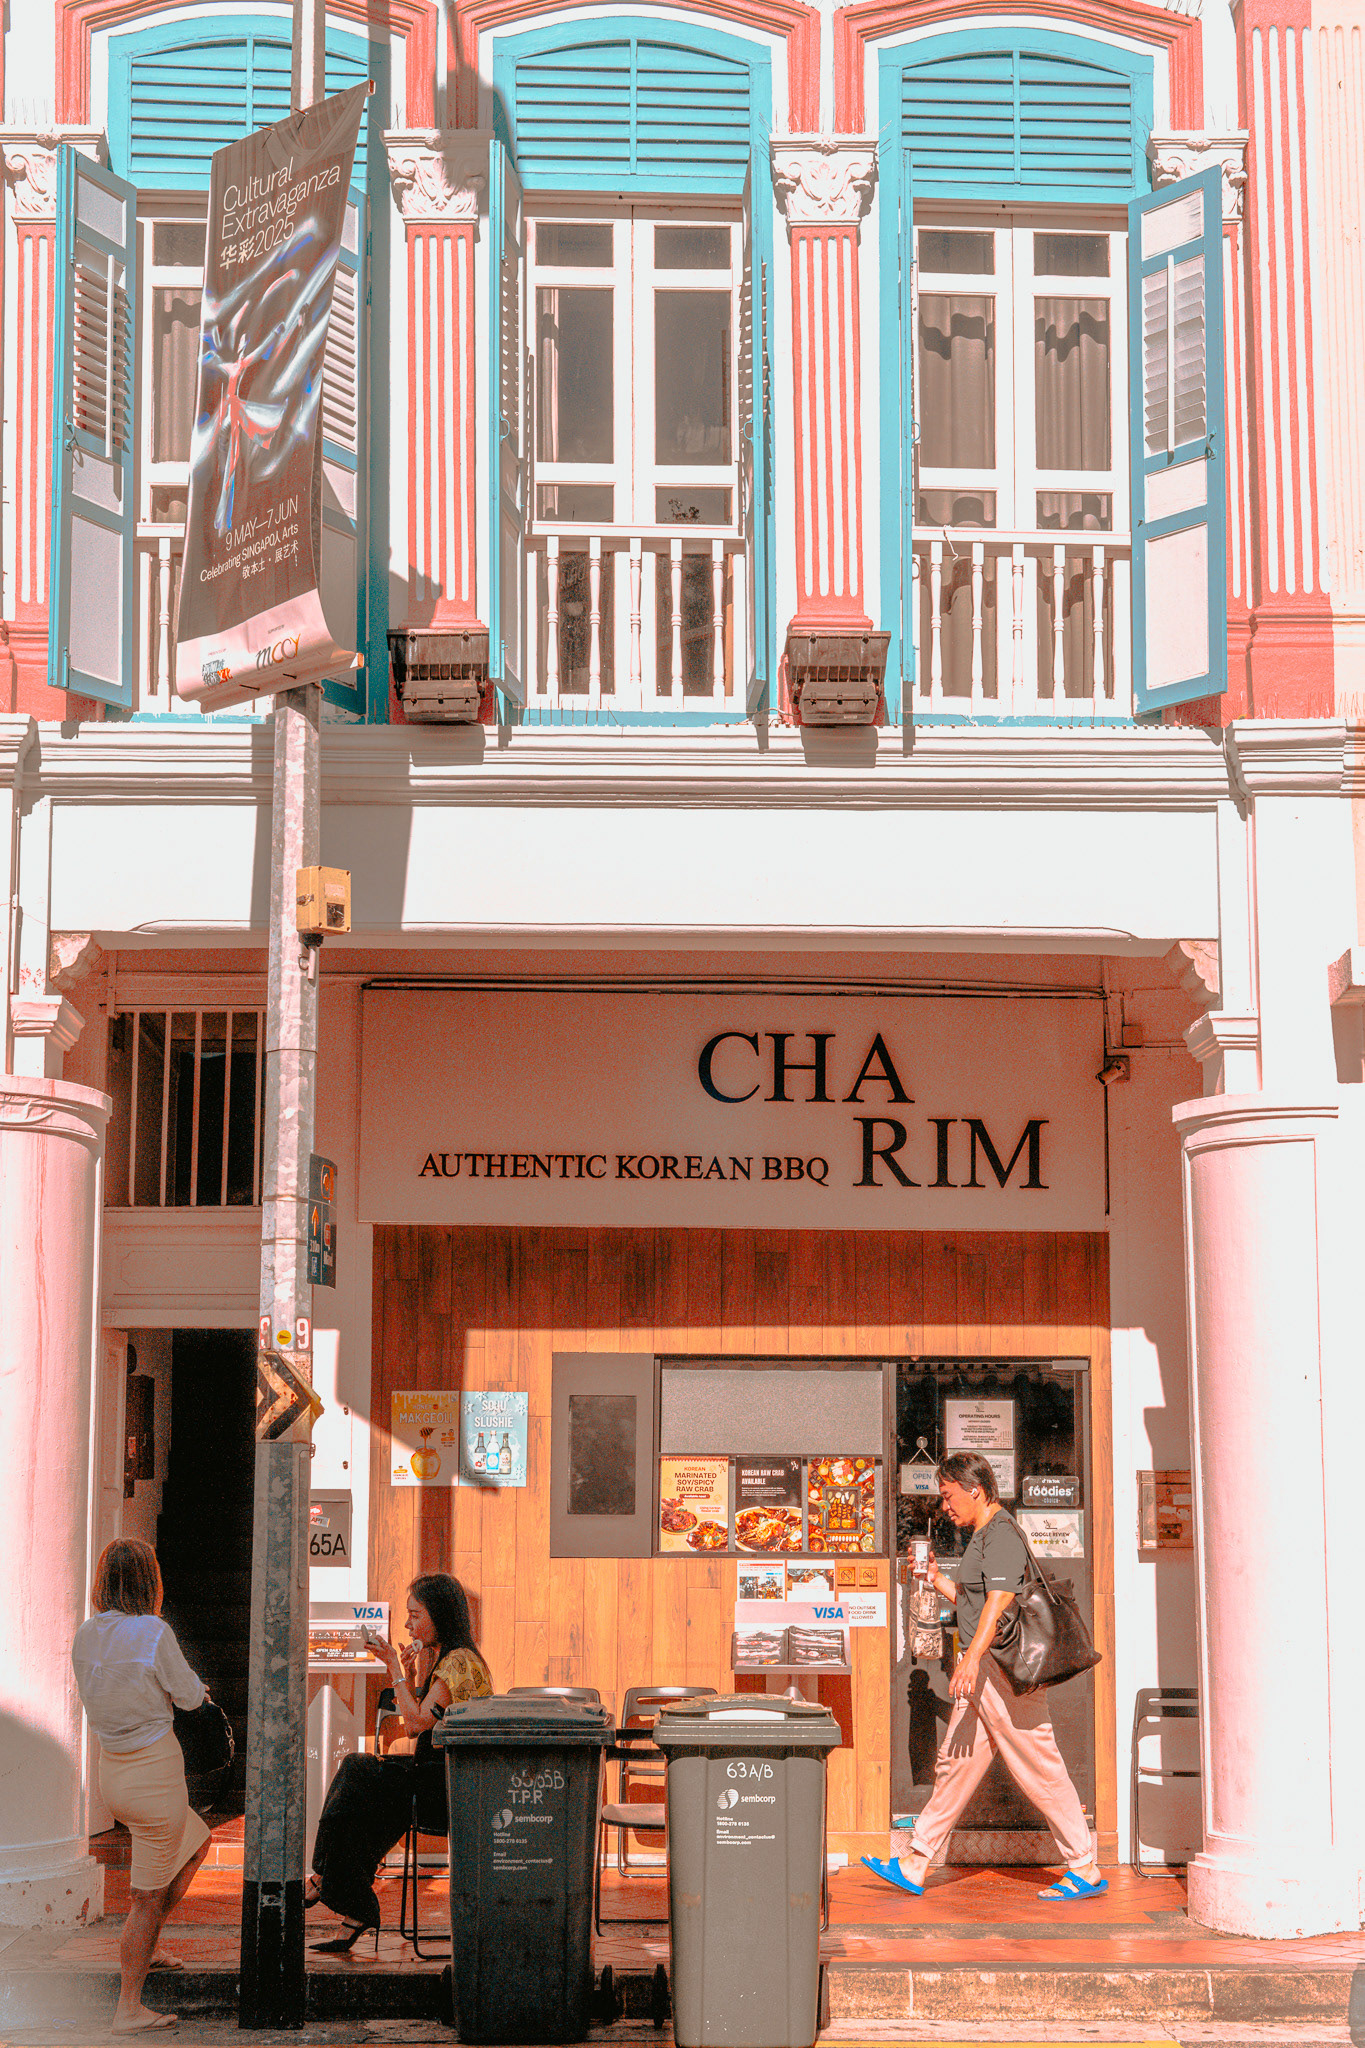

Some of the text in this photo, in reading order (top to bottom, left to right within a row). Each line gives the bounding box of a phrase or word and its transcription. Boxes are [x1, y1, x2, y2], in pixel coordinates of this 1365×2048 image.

[223, 156, 293, 212] Cultural
[221, 165, 341, 240] Extravaganza
[225, 531, 233, 552] 9
[274, 494, 298, 525] JUN
[200, 553, 241, 582] Celebrating
[282, 523, 299, 541] Arts
[698, 1031, 915, 1104] CHA
[417, 1116, 1051, 1190] AUTHENTIC KOREAN BBQ RIM
[296, 1317, 309, 1350] 9
[481, 1399, 507, 1411] SOJU
[399, 1412, 453, 1424] MAKGEOLI
[474, 1416, 514, 1428] SLUSHIE
[741, 1469, 785, 1477] KOREAN RAW CRAB
[912, 1472, 932, 1480] OPEN
[309, 1533, 347, 1556] 65A
[352, 1607, 384, 1619] VISA
[811, 1606, 845, 1619] VISA
[740, 1793, 776, 1805] sembcorp
[514, 1813, 553, 1825] sembcorp
